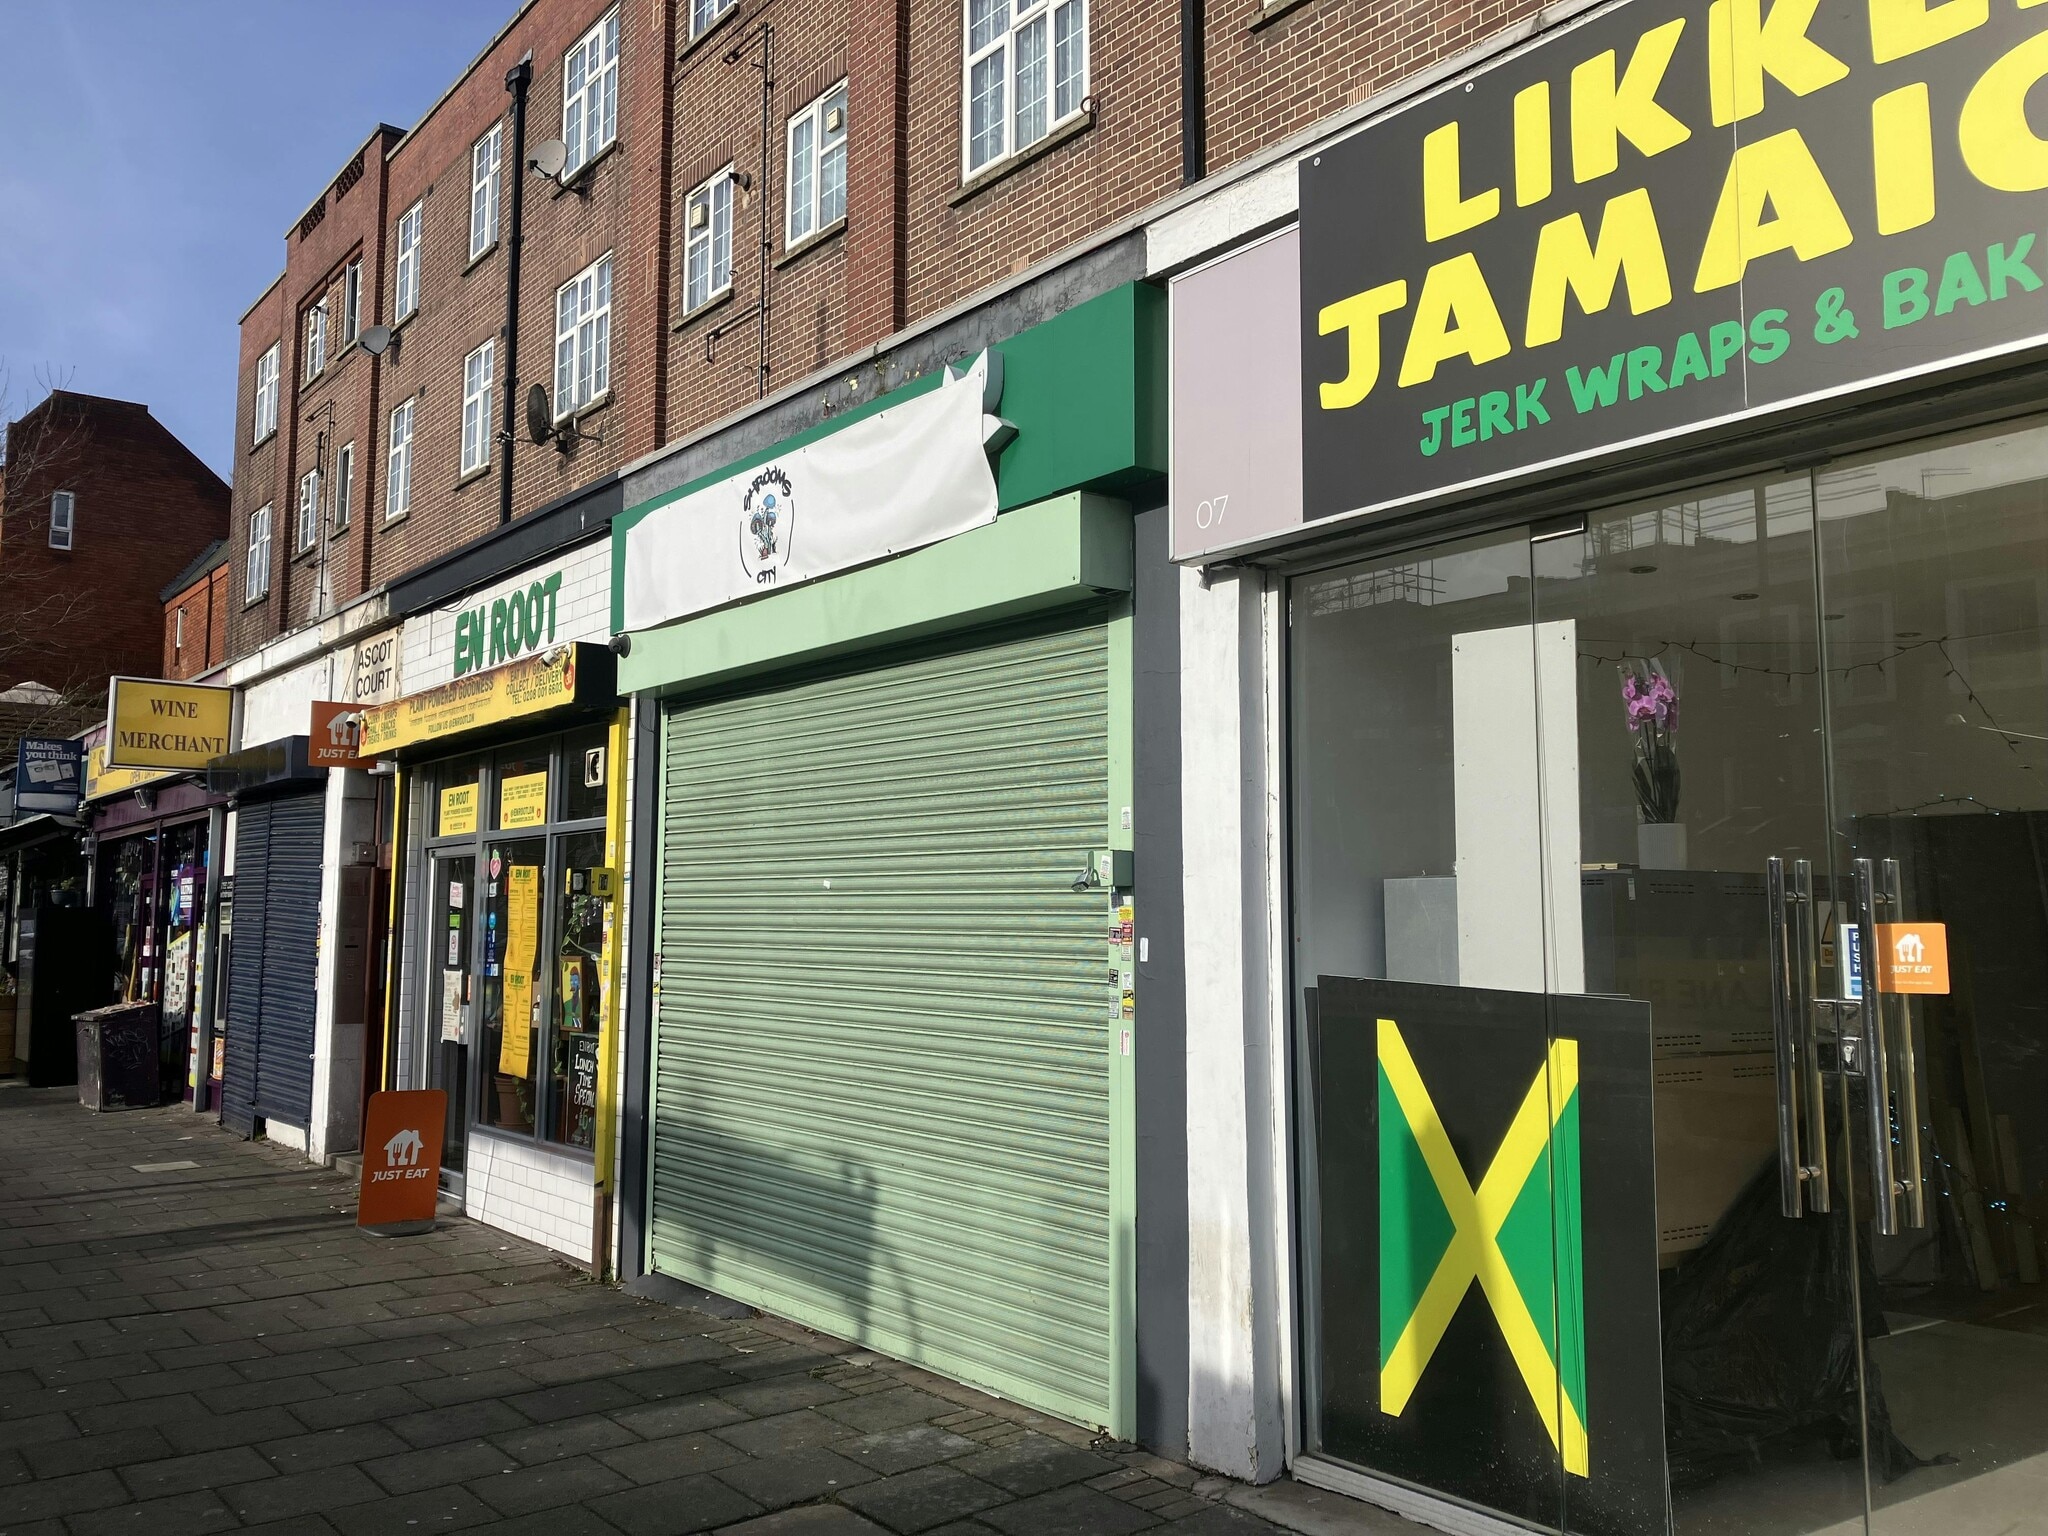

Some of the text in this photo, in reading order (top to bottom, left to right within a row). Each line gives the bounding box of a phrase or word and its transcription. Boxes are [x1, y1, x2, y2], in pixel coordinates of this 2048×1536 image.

[1418, 232, 2046, 458] JERK WRAPS & BAK
[1195, 493, 1230, 531] 07
[756, 565, 777, 584] CITY
[453, 571, 563, 679] EN ROOT
[356, 638, 394, 672] ASCOT
[355, 668, 394, 699] COURT
[506, 677, 530, 696] COLLECT
[535, 667, 563, 688] DELIVERY
[409, 696, 427, 716] PLANT
[428, 687, 457, 710] POWERED
[458, 675, 494, 700] GOODNESS
[150, 698, 199, 719] WINE
[26, 741, 62, 751] Makes
[119, 730, 225, 754] MERCHANT
[26, 750, 77, 760] you think
[317, 748, 346, 759] JUST
[448, 790, 470, 807] EN ROOT
[1890, 965, 1933, 974] JUST EAT
[574, 1053, 595, 1074] LUNCH
[578, 1071, 593, 1088] TIME
[371, 1168, 430, 1183] JUST EAT
